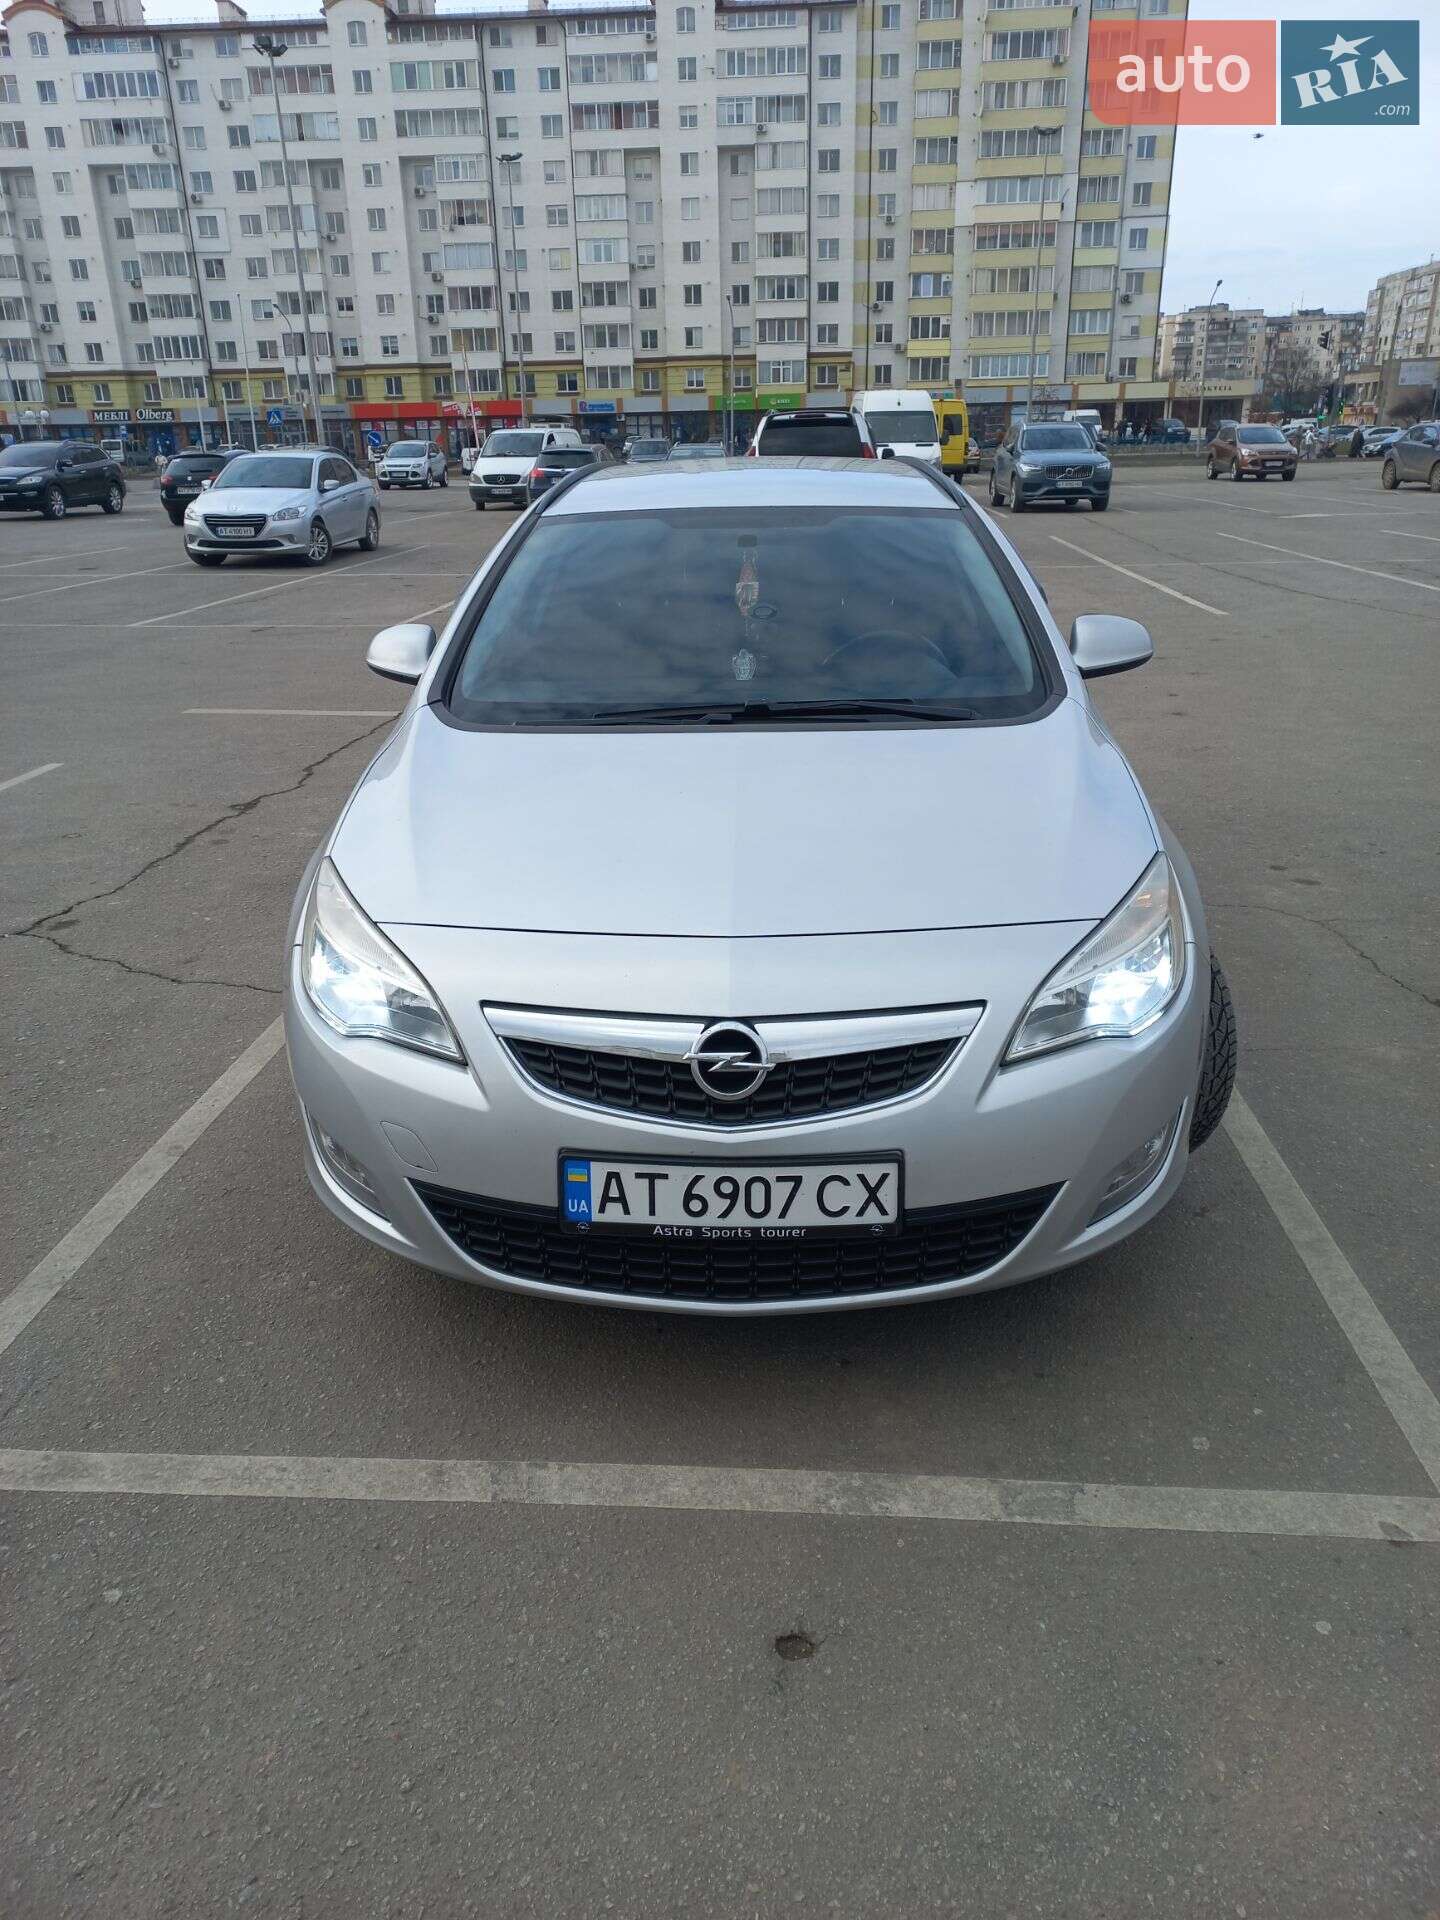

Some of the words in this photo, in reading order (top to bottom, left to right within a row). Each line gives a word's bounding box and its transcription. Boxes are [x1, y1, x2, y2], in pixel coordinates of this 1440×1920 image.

[94, 411, 129, 421] МЕБЛІ
[136, 408, 173, 422] Olberg
[597, 1171, 670, 1217] AT
[682, 1174, 804, 1220] 6907
[816, 1172, 891, 1218] CX
[568, 1199, 589, 1213] UA
[653, 1225, 693, 1237] Astra
[701, 1227, 752, 1240] Sports
[760, 1227, 807, 1238] tourer
